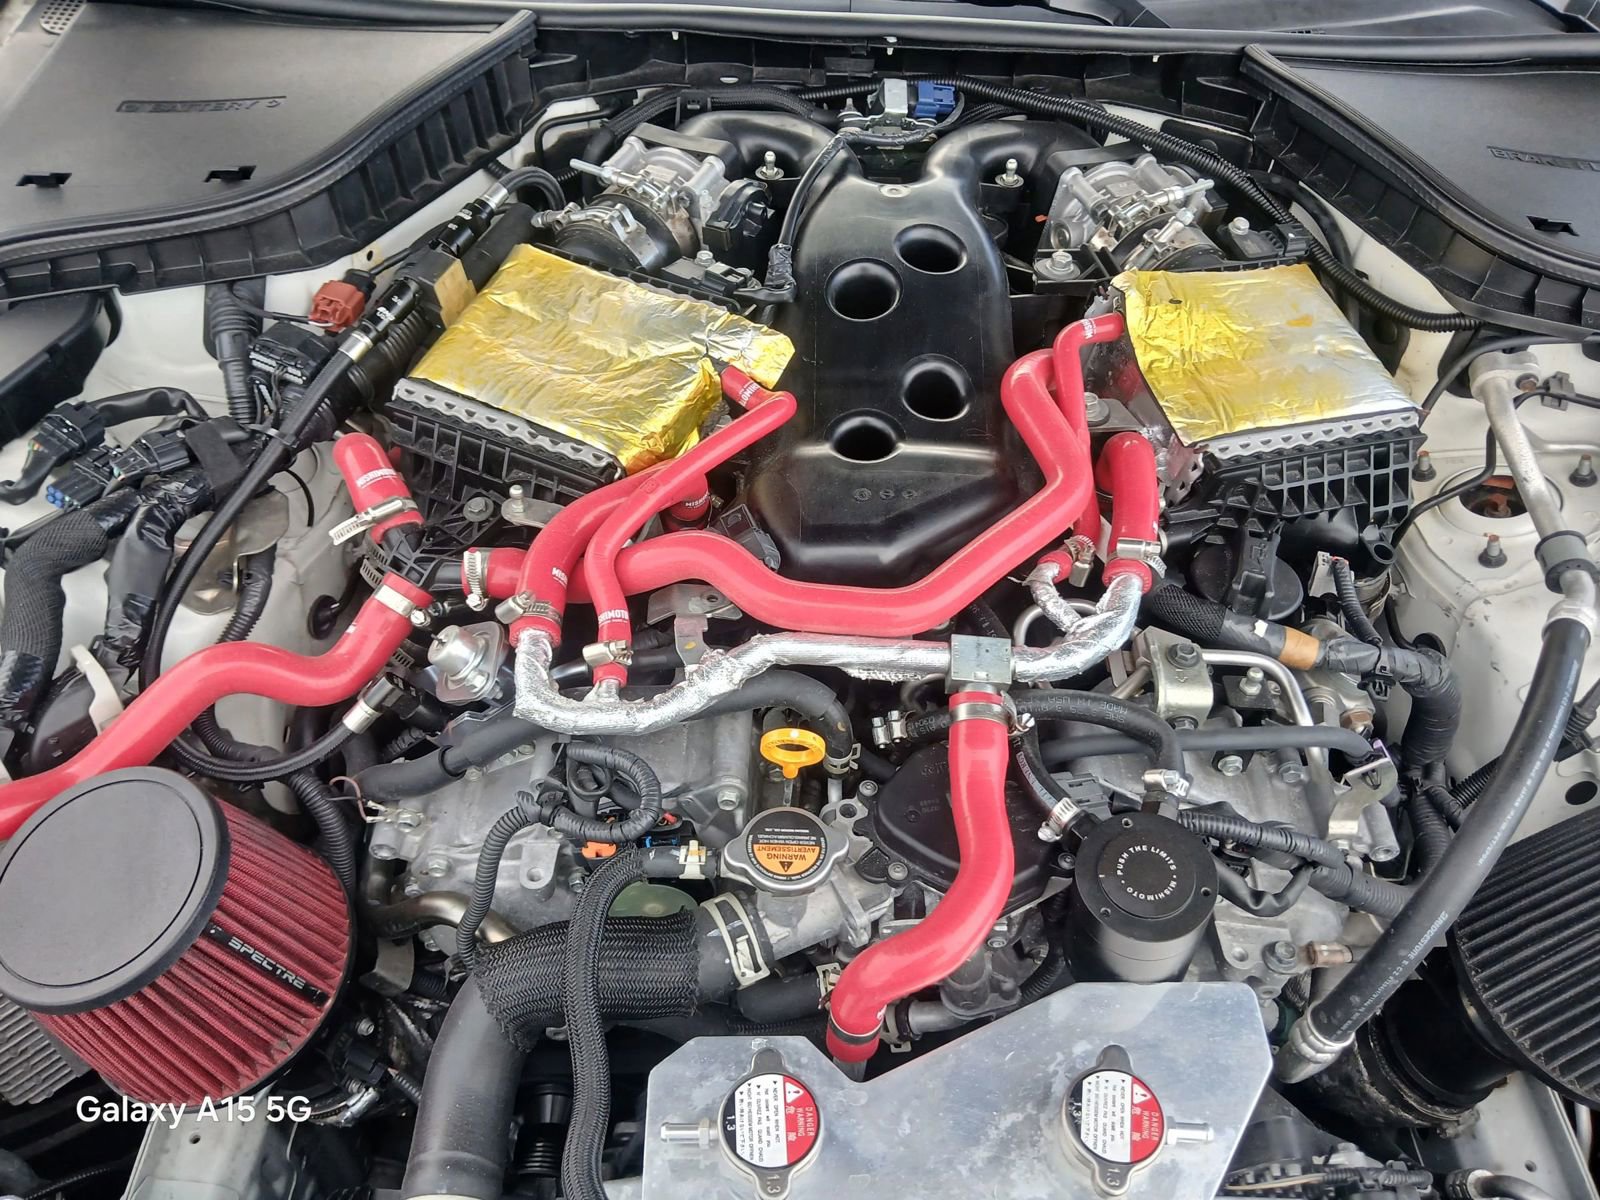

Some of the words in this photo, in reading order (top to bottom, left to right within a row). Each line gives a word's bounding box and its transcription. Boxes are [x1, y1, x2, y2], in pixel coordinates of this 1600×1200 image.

[756, 846, 818, 854] AVERTISSEMENT
[1116, 852, 1129, 876] PUSH
[1128, 844, 1148, 854] THE
[1150, 846, 1177, 870] LIMITS
[1126, 880, 1177, 900] MISHIMOTO
[228, 936, 306, 990] SPECTRE
[725, 1114, 734, 1130] 1.3
[805, 1106, 814, 1136] DANGER
[766, 1175, 780, 1194] 1.3
[1106, 1168, 1120, 1186] 1.3
